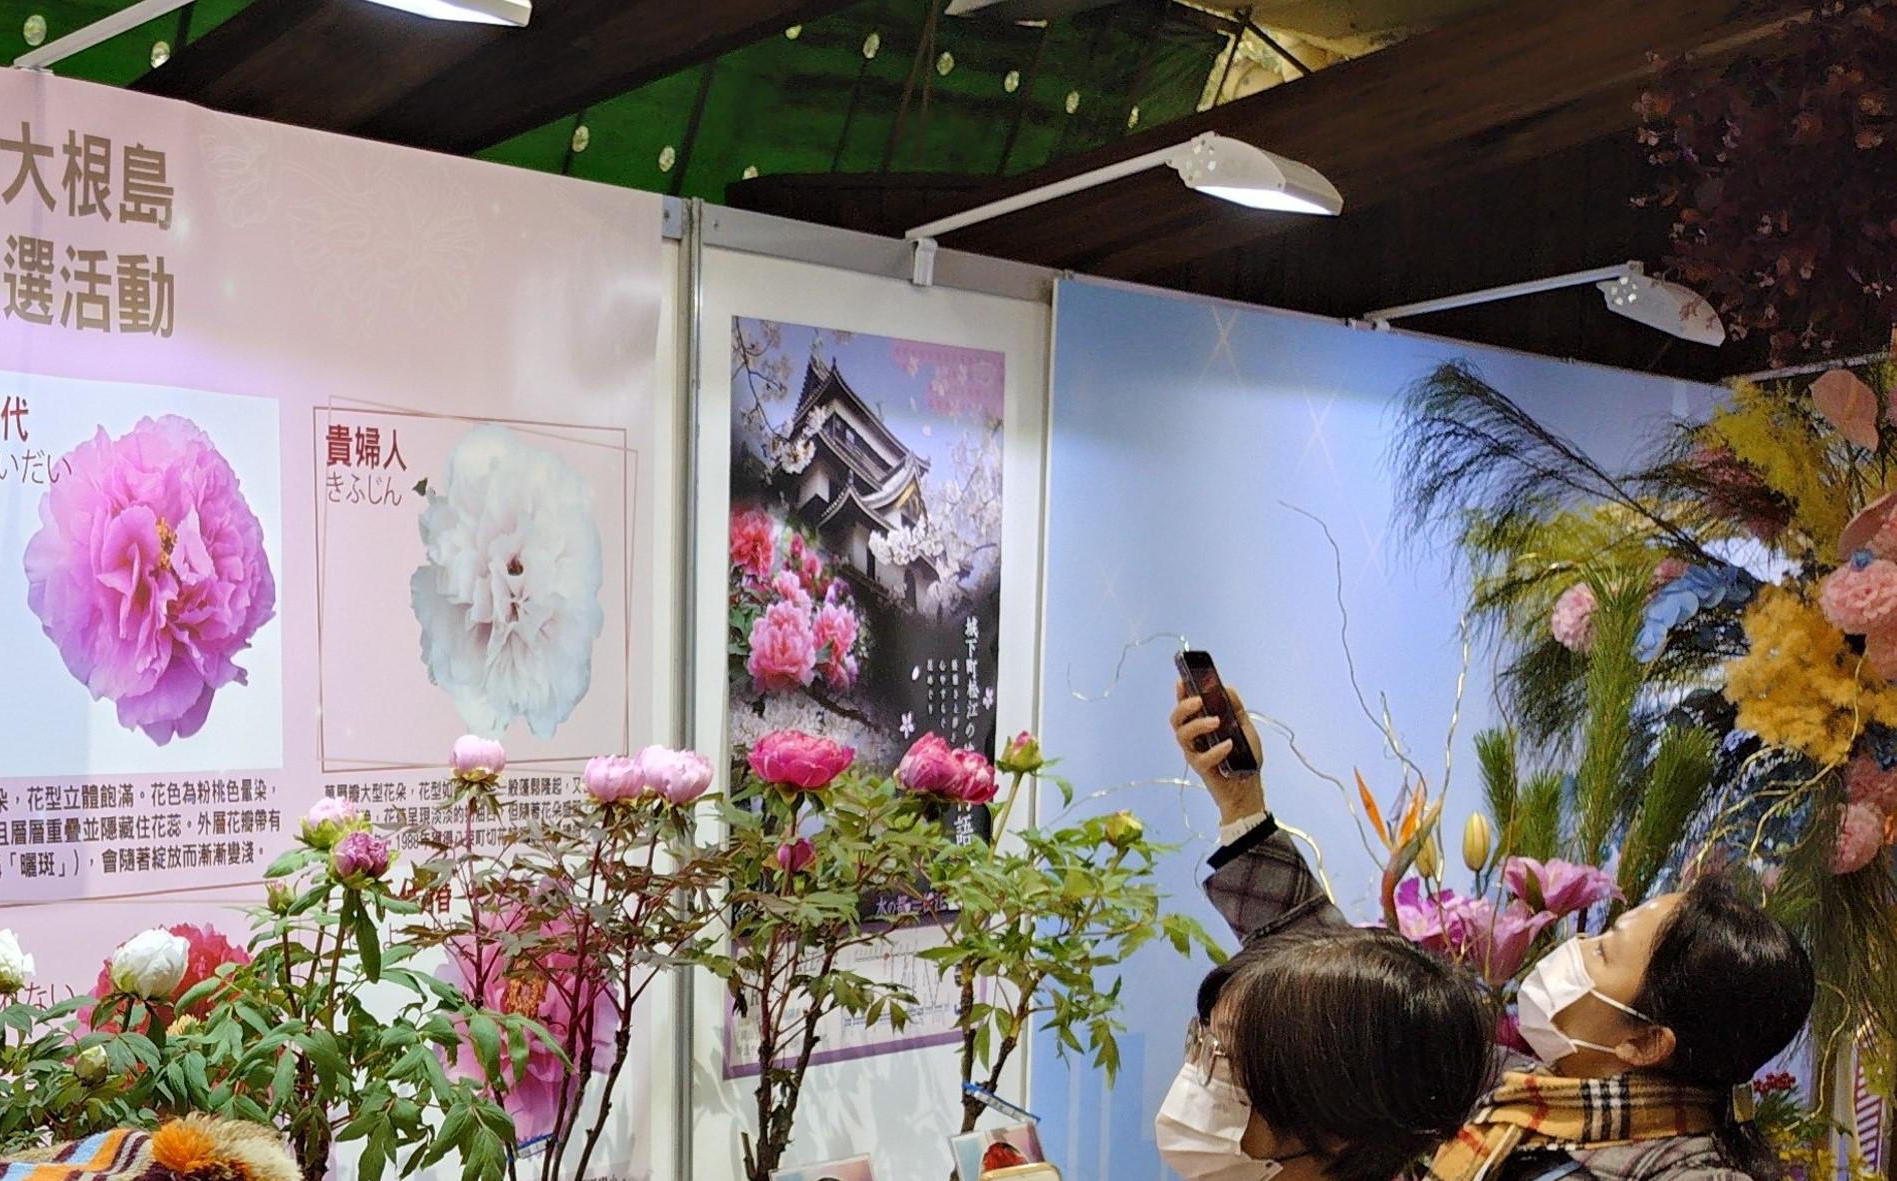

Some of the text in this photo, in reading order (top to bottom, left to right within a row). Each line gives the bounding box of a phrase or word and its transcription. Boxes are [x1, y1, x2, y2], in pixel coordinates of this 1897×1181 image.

[325, 424, 407, 472] 貴婦人
[326, 471, 403, 506] きふじん
